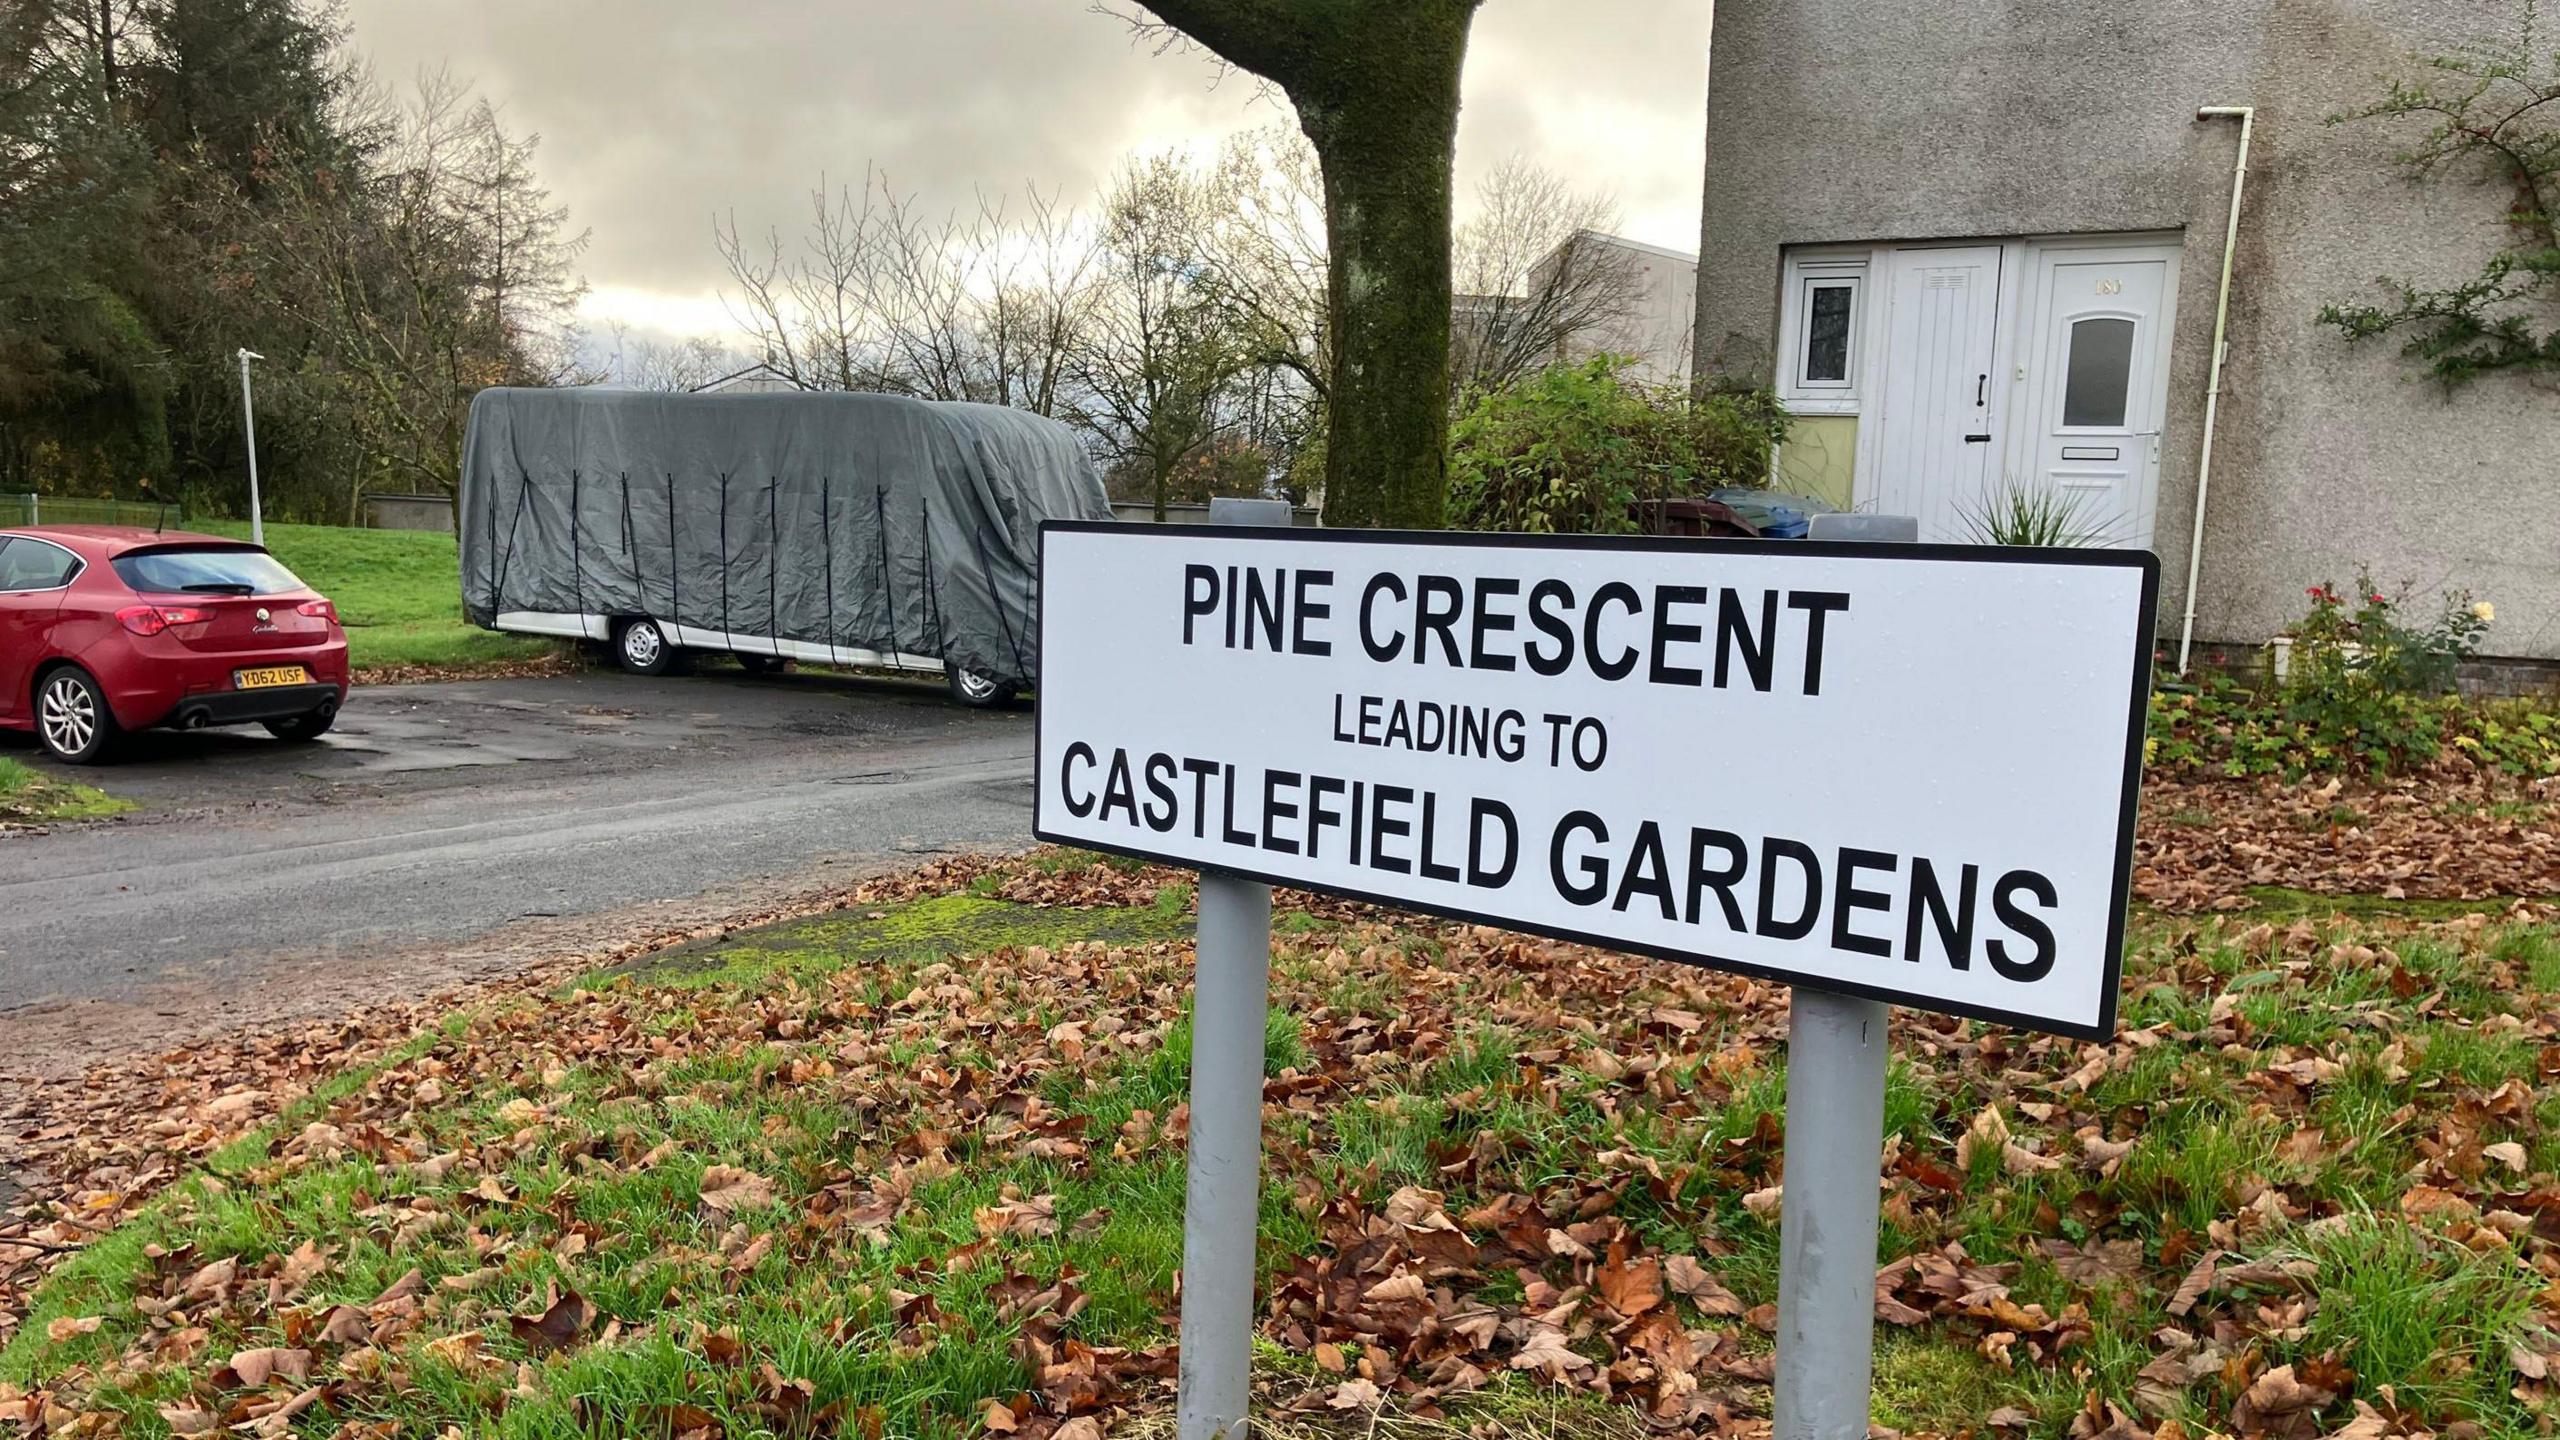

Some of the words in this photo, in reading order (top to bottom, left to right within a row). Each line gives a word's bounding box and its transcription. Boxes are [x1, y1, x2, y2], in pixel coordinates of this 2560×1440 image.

[242, 670, 277, 686] YD62
[278, 668, 302, 683] USF
[1184, 563, 1334, 657] PINE
[1360, 571, 1851, 697] CRESCENT
[1333, 694, 1526, 763] LEADING
[1543, 714, 1608, 771] TO
[1062, 742, 1519, 888] CASTLEFIELD
[1550, 811, 2058, 982] GARDENS
